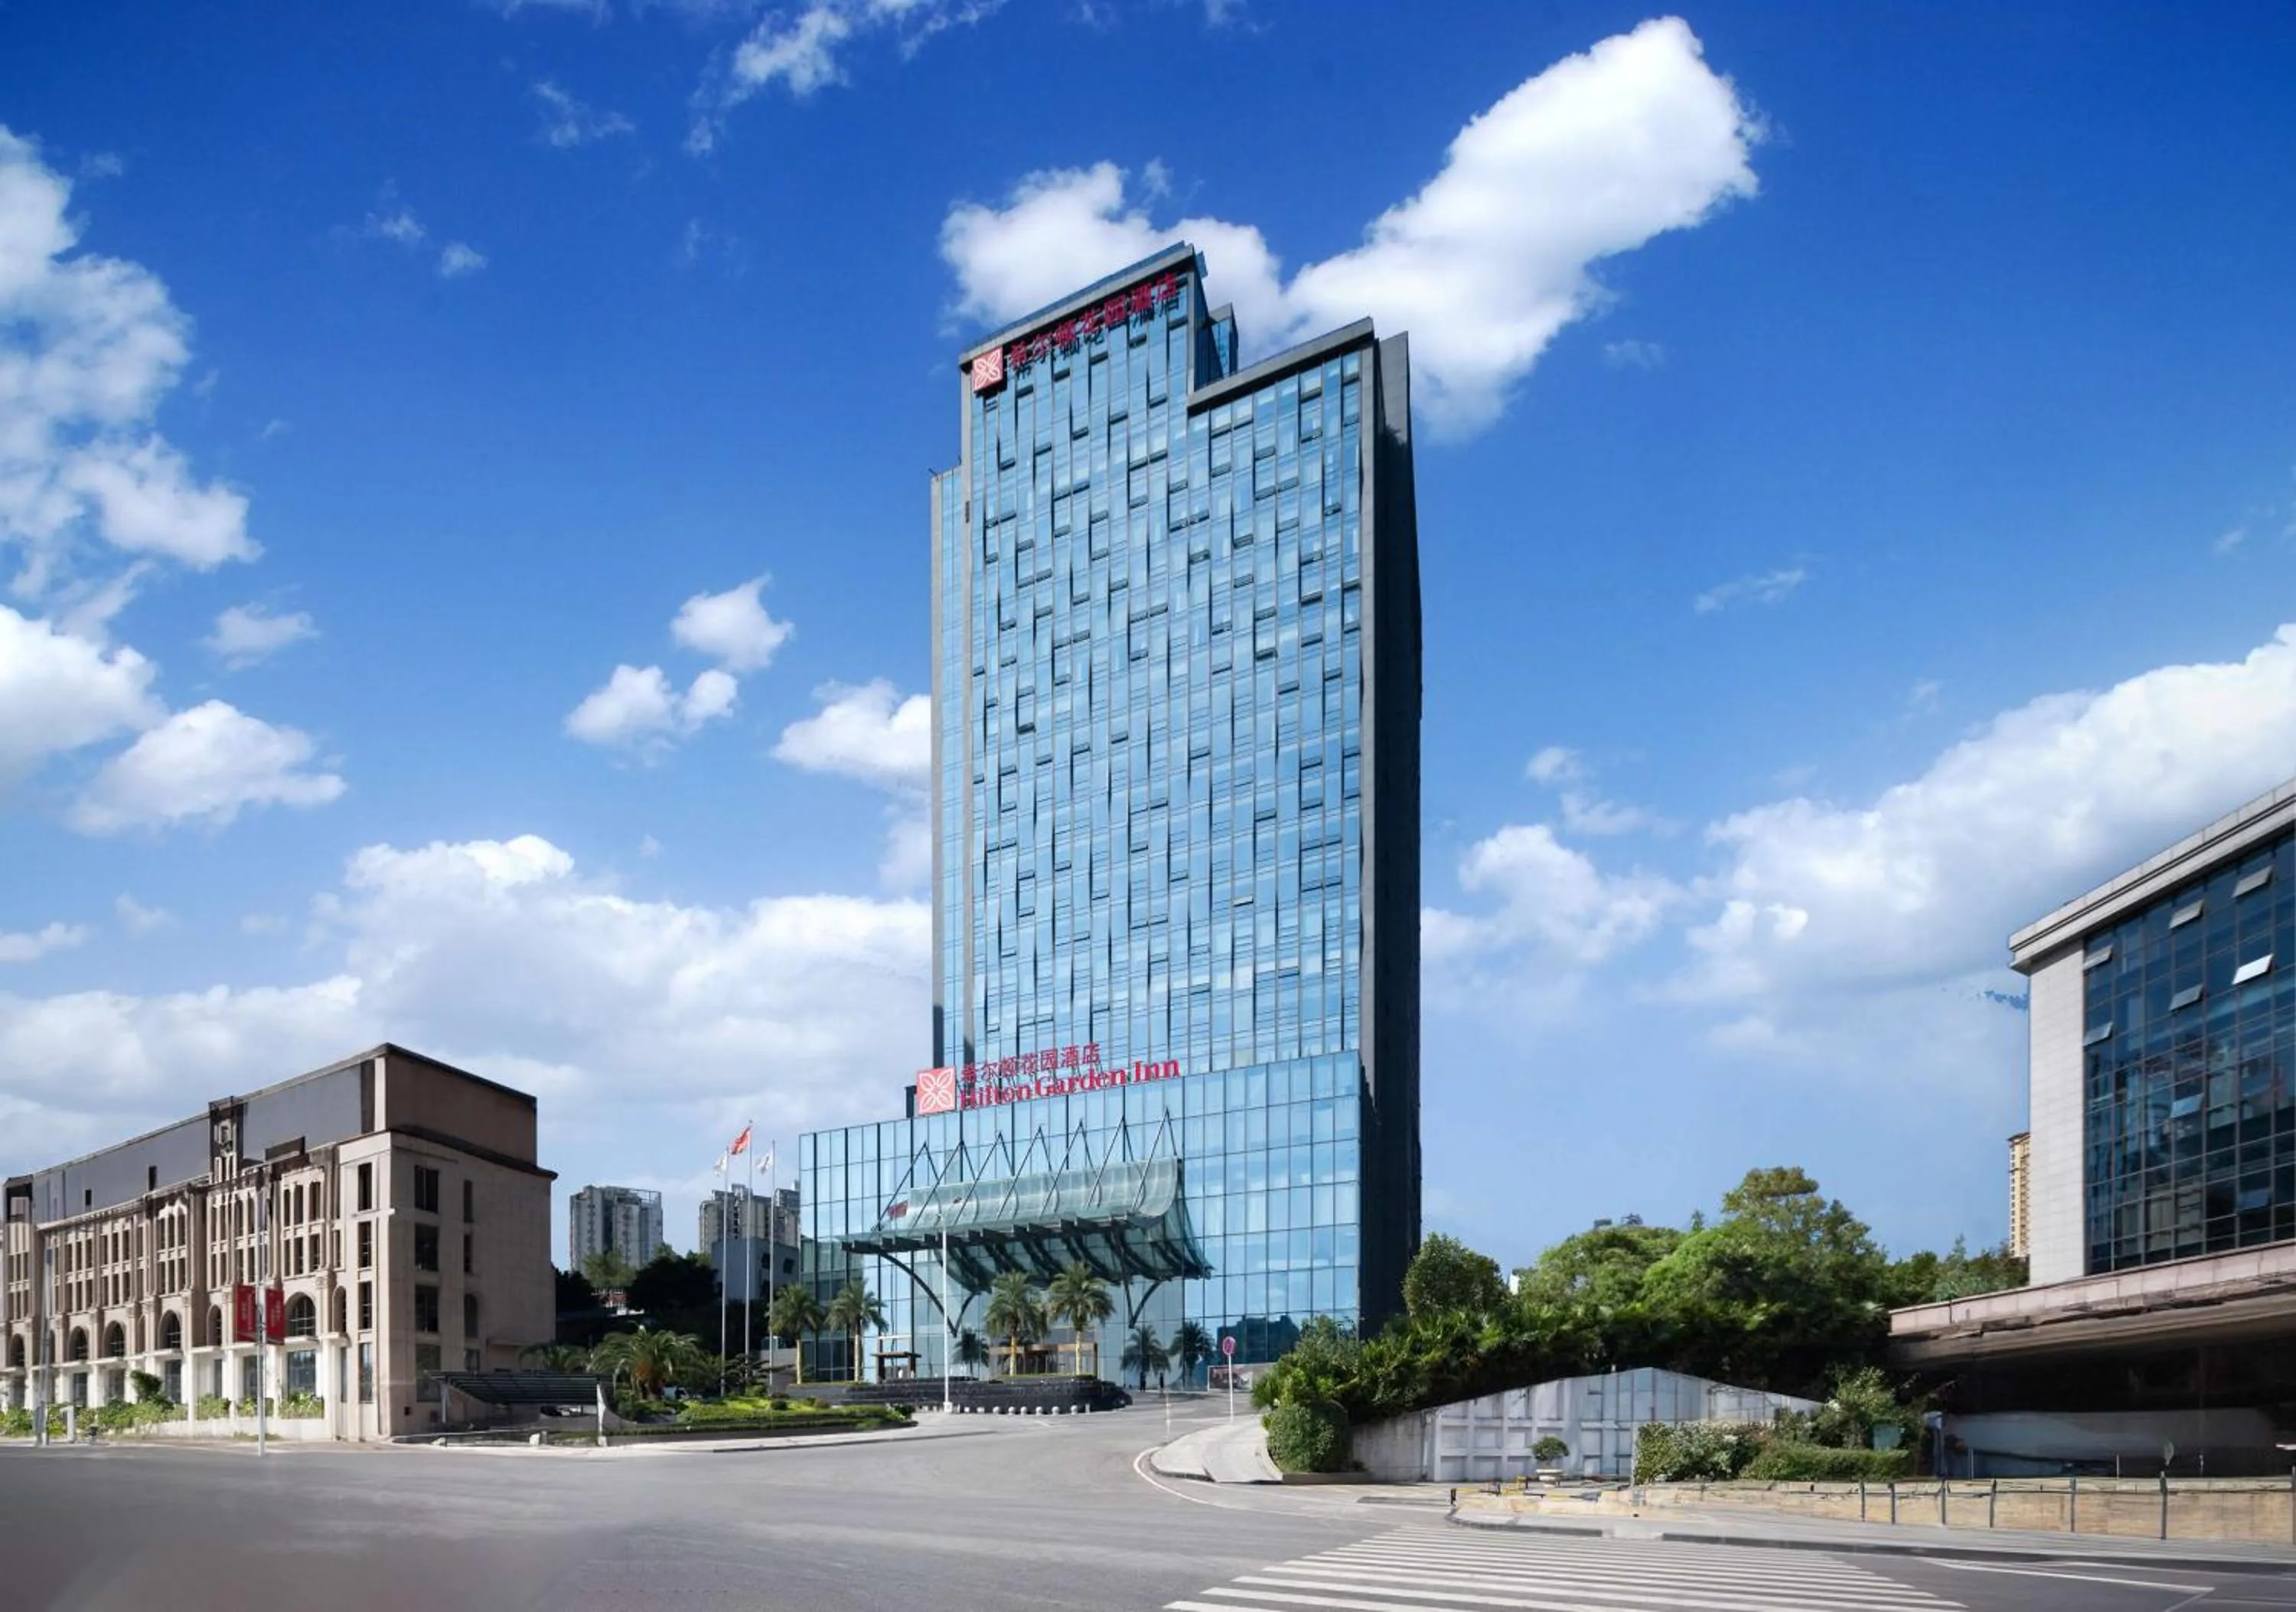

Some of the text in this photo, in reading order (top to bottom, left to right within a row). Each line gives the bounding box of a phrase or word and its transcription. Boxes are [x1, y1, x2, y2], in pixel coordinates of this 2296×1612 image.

[960, 1059, 1181, 1110] Hilton Garden Inn
[962, 1042, 1101, 1084] 希尔顿花园酒店
